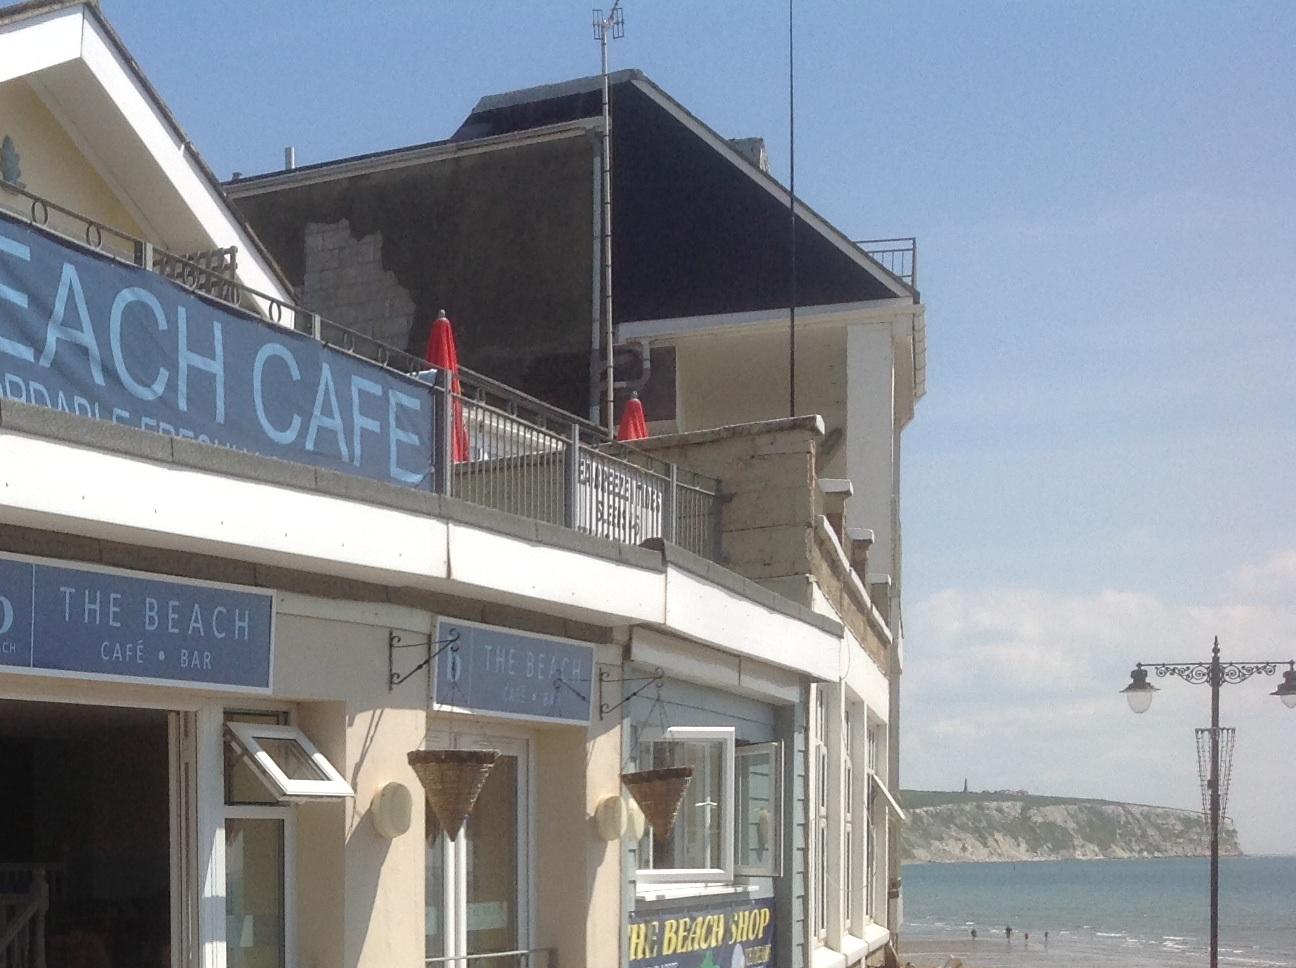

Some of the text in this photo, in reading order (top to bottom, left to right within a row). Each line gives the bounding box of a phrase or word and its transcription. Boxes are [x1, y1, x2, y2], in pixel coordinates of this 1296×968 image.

[252, 341, 428, 482] CAFE
[60, 586, 250, 641] THE BEACH
[101, 640, 212, 670] CAFÉ BAR
[484, 645, 582, 681] THE BEACH
[629, 921, 660, 961] HE
[663, 914, 724, 955] BEACH
